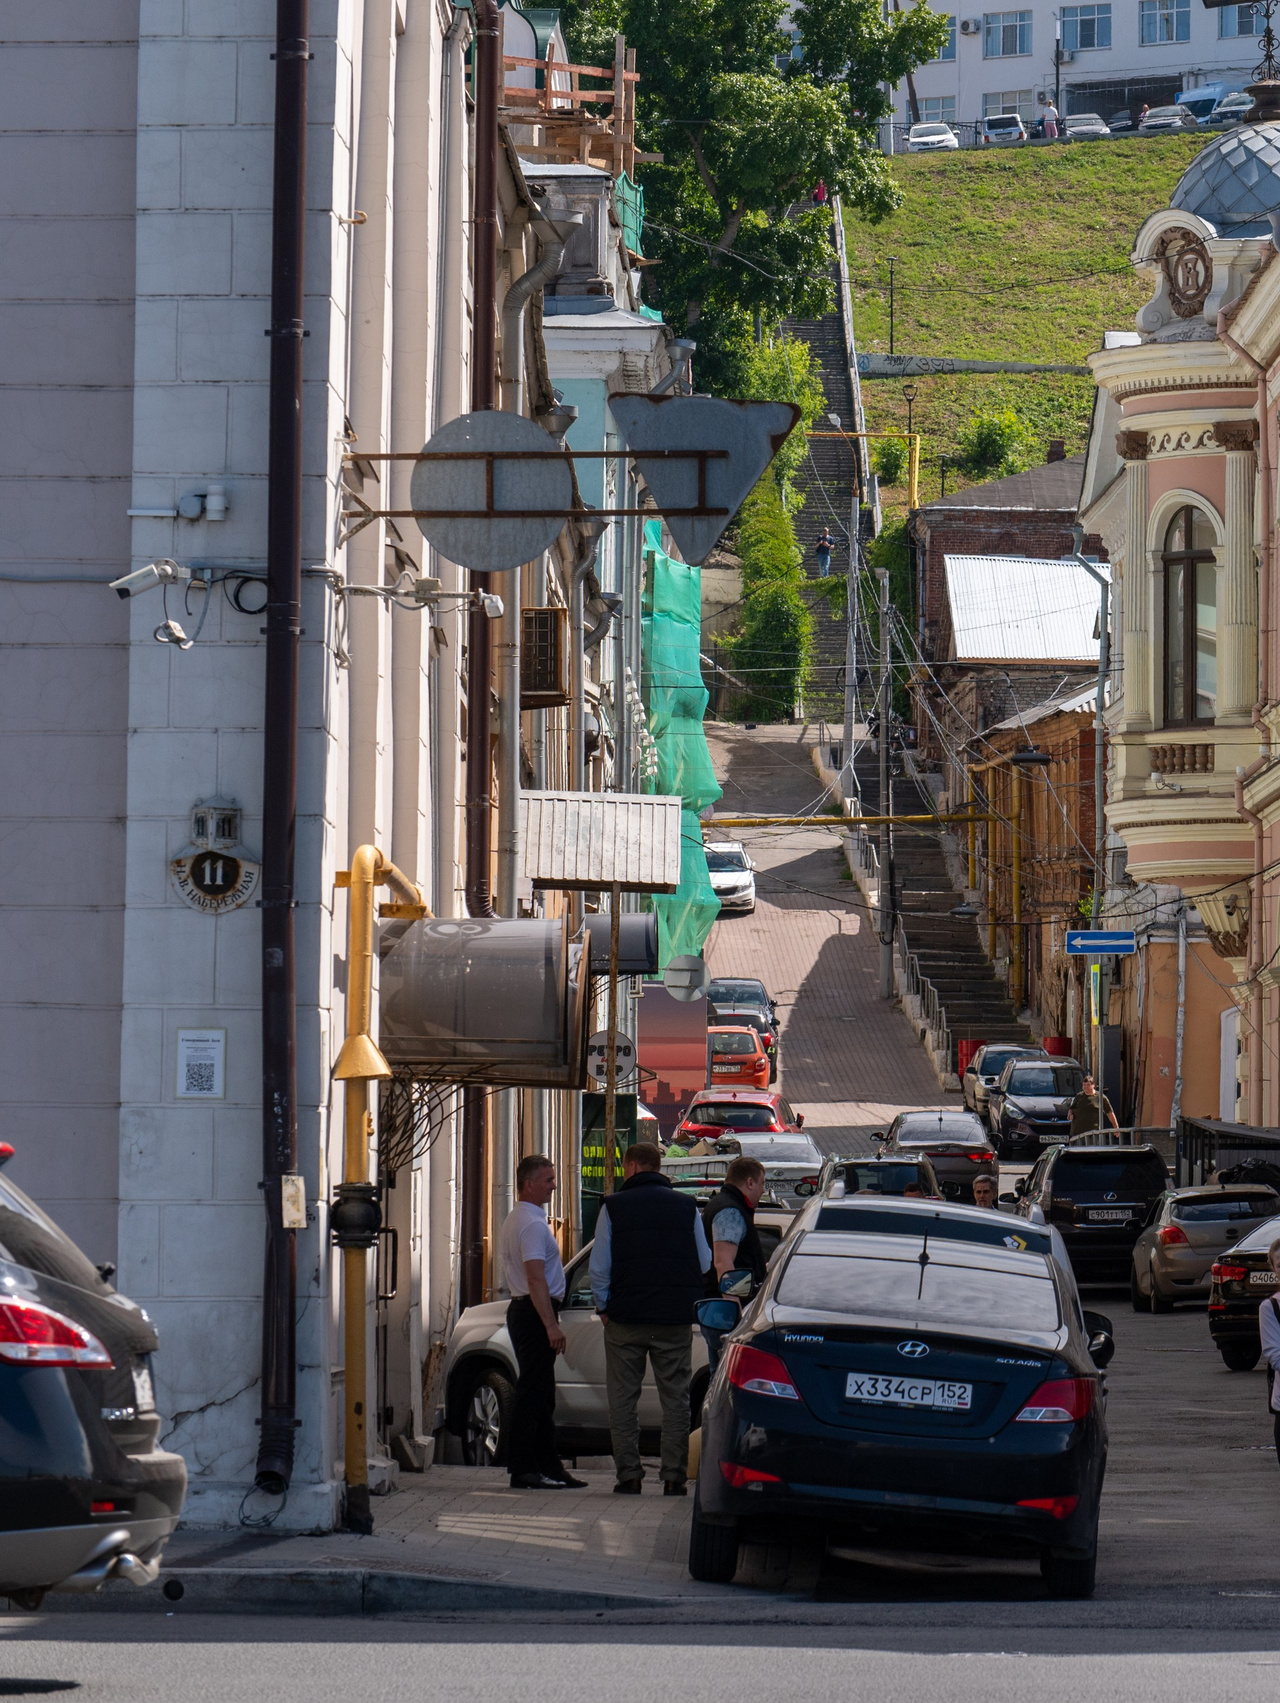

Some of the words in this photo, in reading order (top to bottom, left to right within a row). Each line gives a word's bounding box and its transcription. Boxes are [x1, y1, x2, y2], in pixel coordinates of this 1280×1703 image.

[202, 859, 224, 885] 11
[186, 870, 255, 909] НАБЕРЕЖНАЯ
[588, 1045, 631, 1057] РЕРО
[596, 1065, 624, 1077] БР
[784, 1333, 825, 1344] HYUNDAI
[995, 1357, 1042, 1367] SOLARIS
[853, 1377, 932, 1401] Х334СР
[937, 1383, 967, 1400] 152
[941, 1398, 957, 1406] RUS
